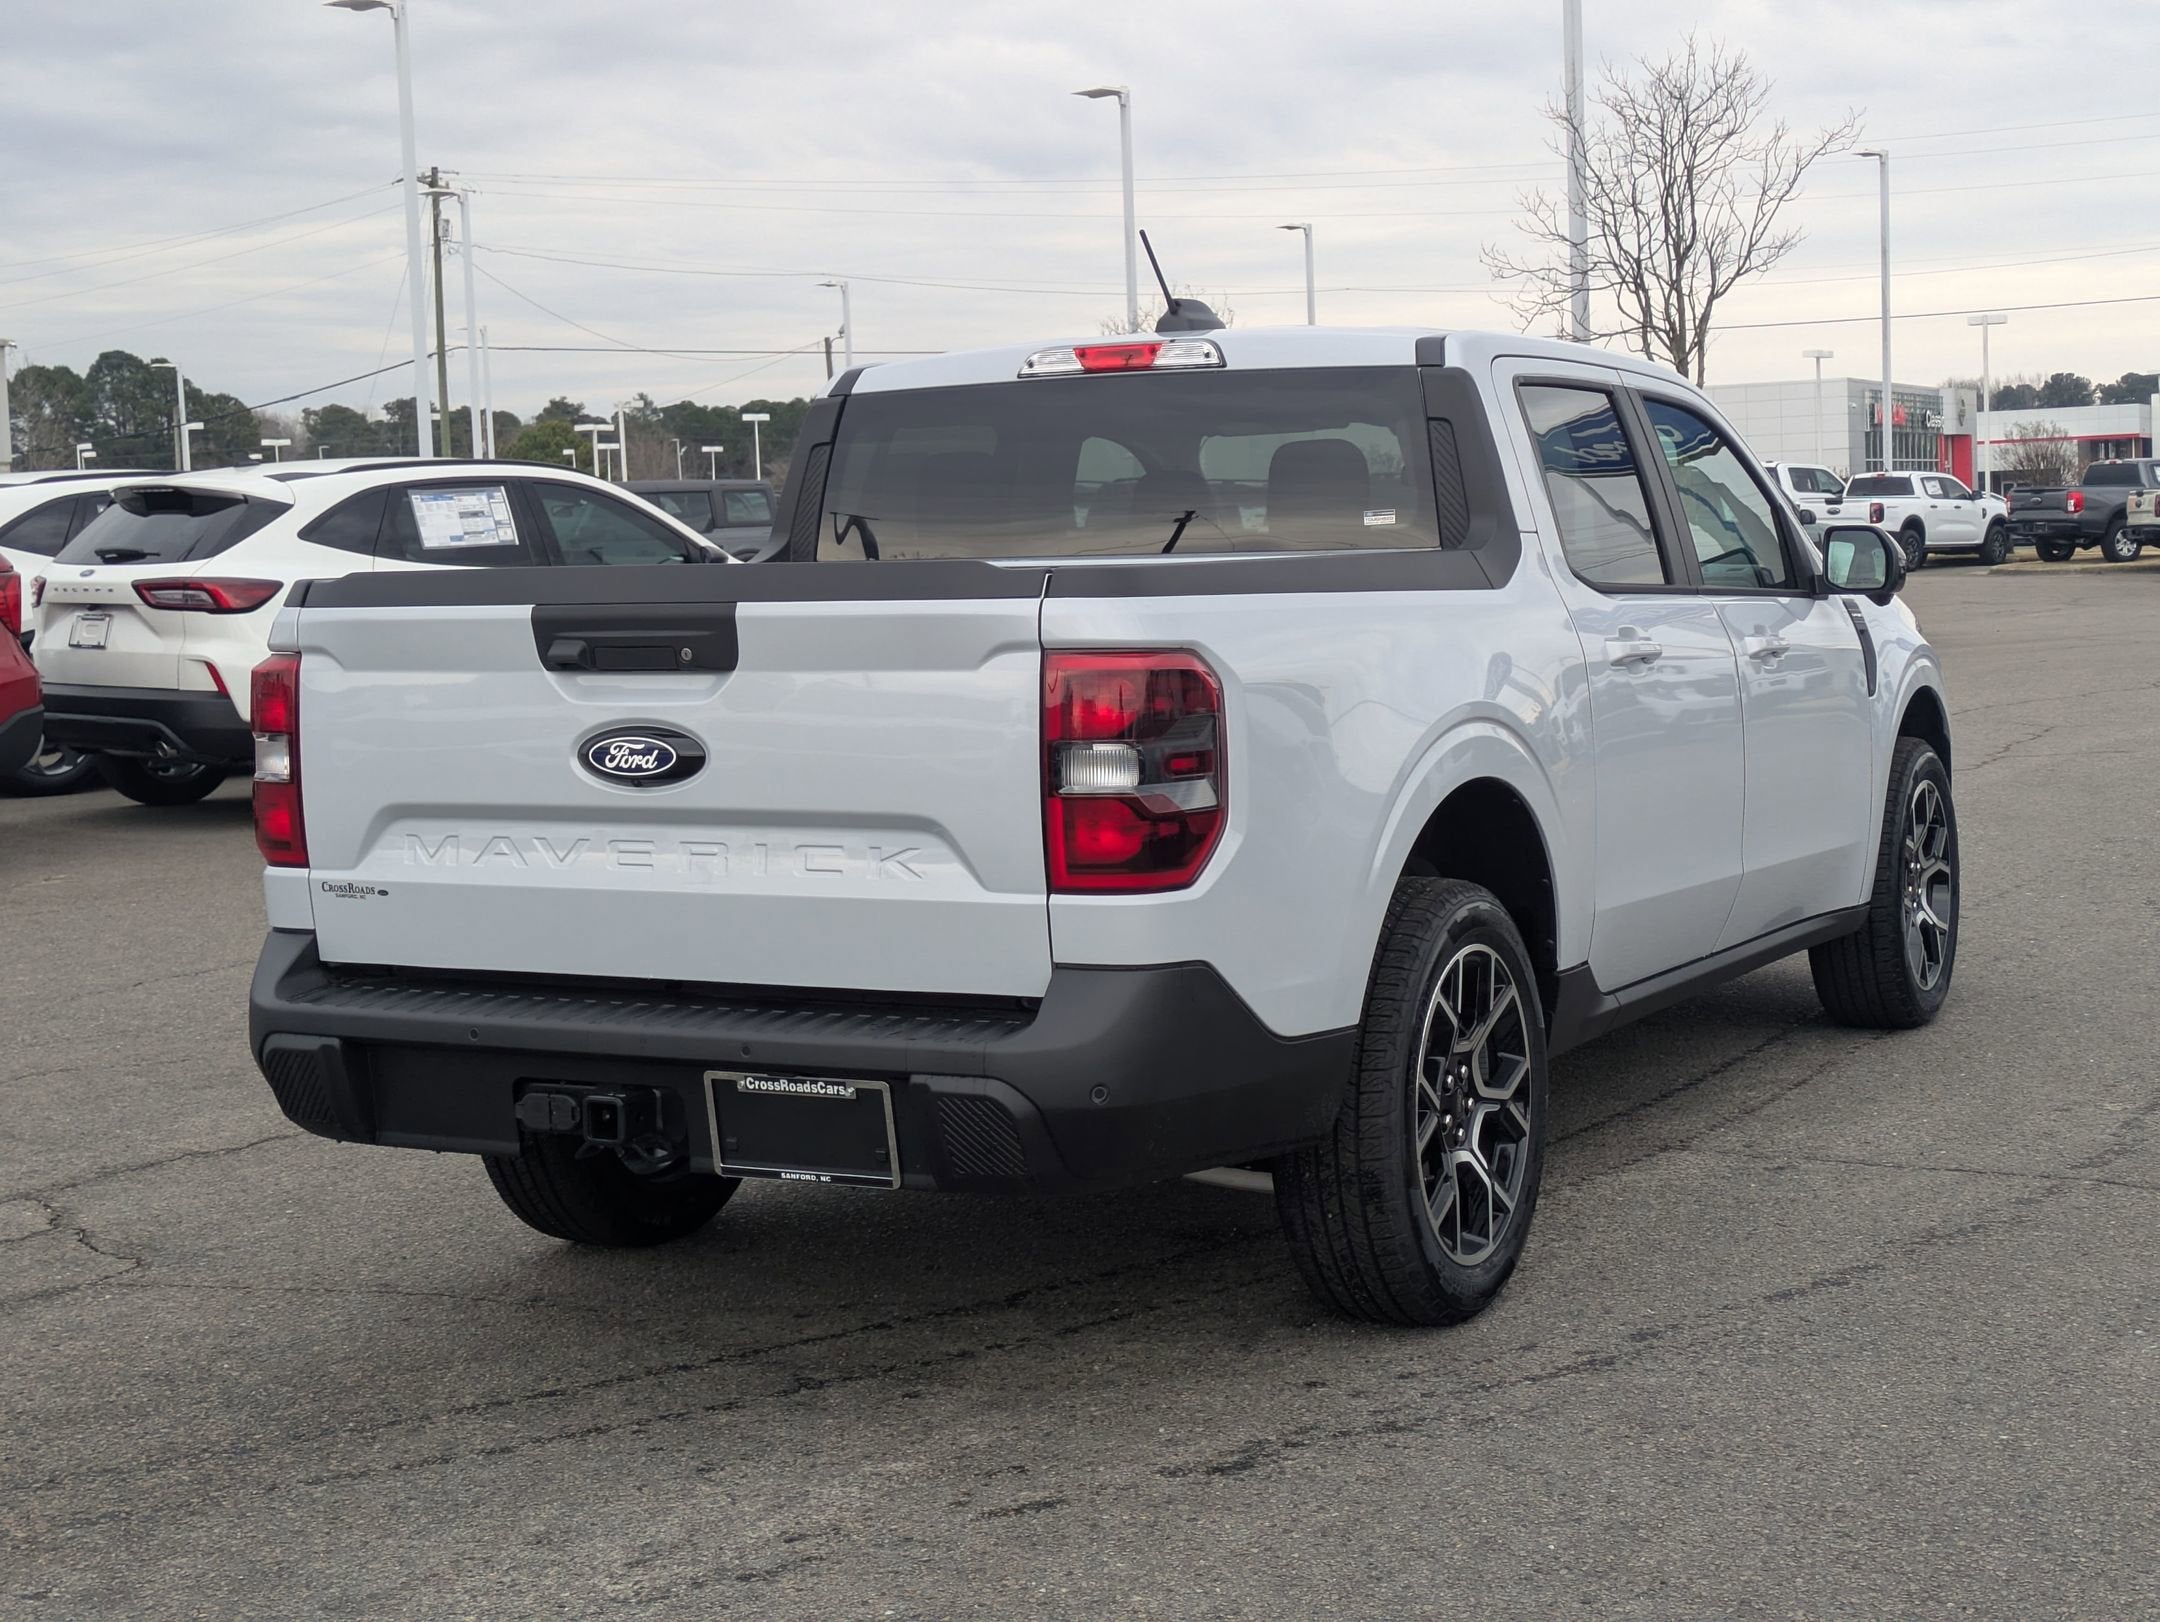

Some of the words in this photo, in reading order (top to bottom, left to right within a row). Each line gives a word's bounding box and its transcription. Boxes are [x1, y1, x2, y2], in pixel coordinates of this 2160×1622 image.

[604, 741, 660, 769] Ford
[404, 833, 924, 881] MAVERICK
[745, 1076, 846, 1096] CrossRoadsCars
[820, 1175, 832, 1183] NC
